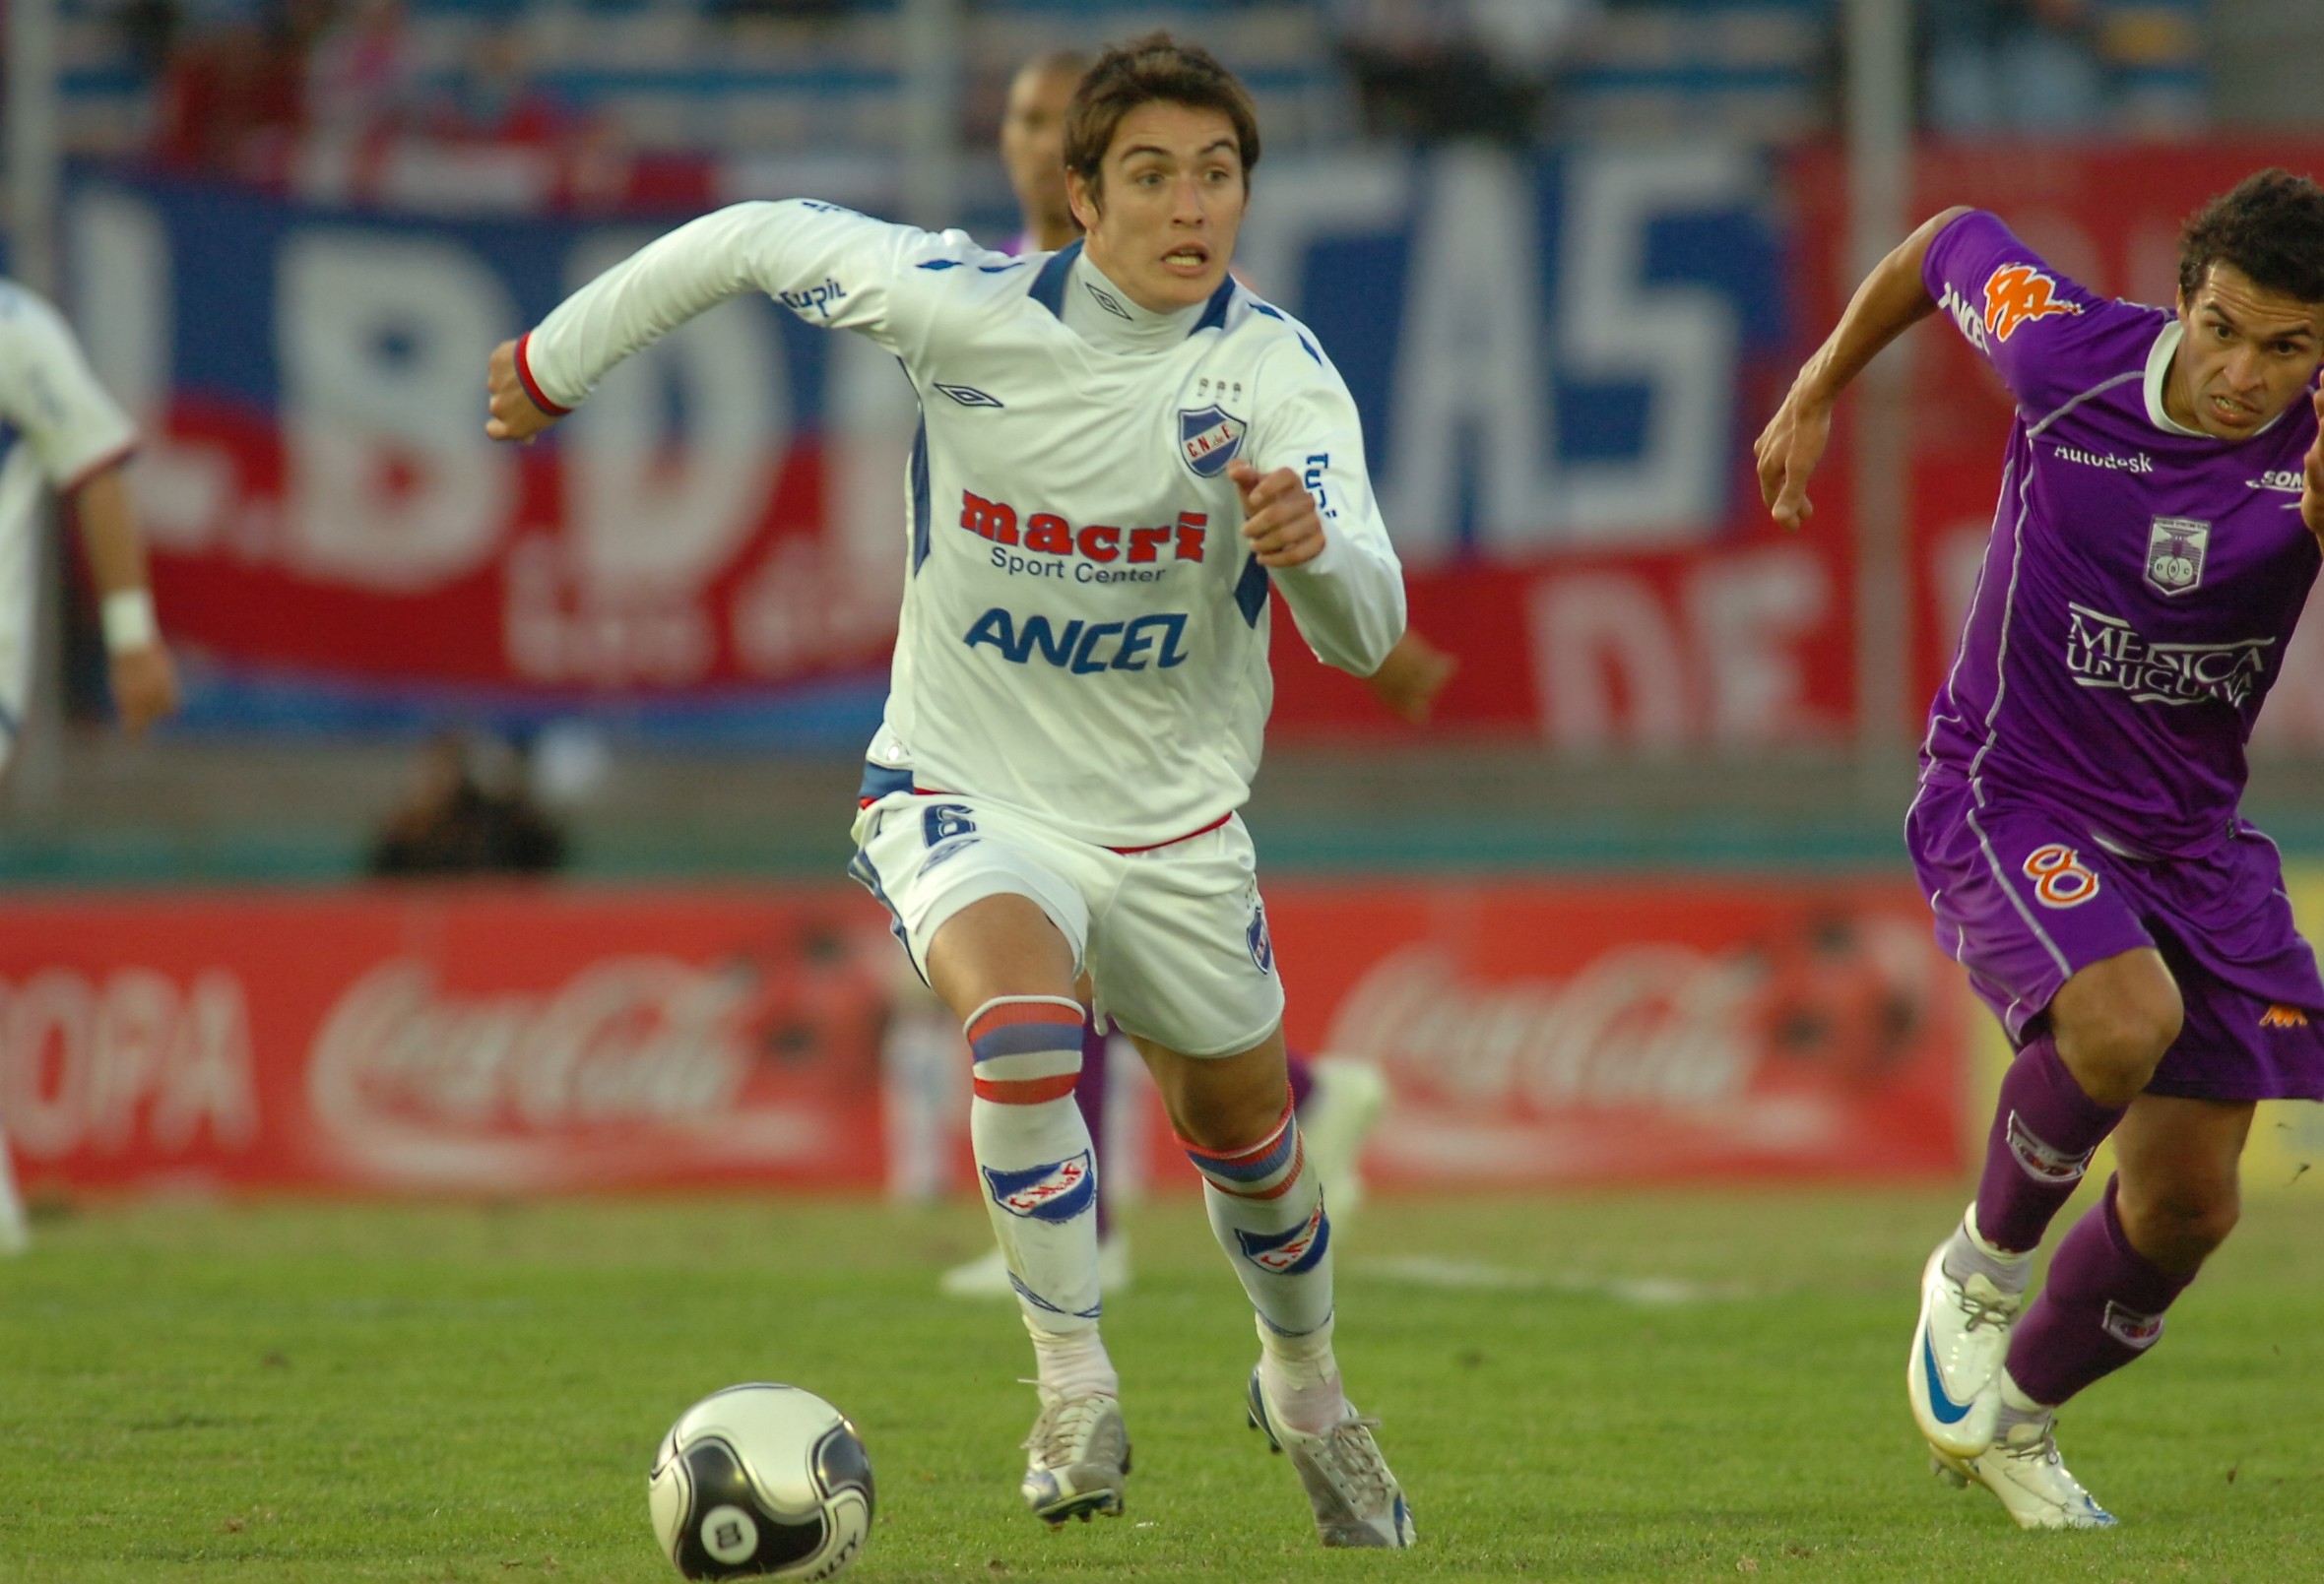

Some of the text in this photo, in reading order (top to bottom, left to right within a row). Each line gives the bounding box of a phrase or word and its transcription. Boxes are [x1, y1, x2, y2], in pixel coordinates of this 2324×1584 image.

[960, 489, 1208, 564] macri
[991, 546, 1167, 584] Sport Center
[963, 607, 1189, 674] ANCEL
[922, 803, 976, 848] 6
[2022, 843, 2099, 909] 8
[0, 965, 261, 1159] OPA
